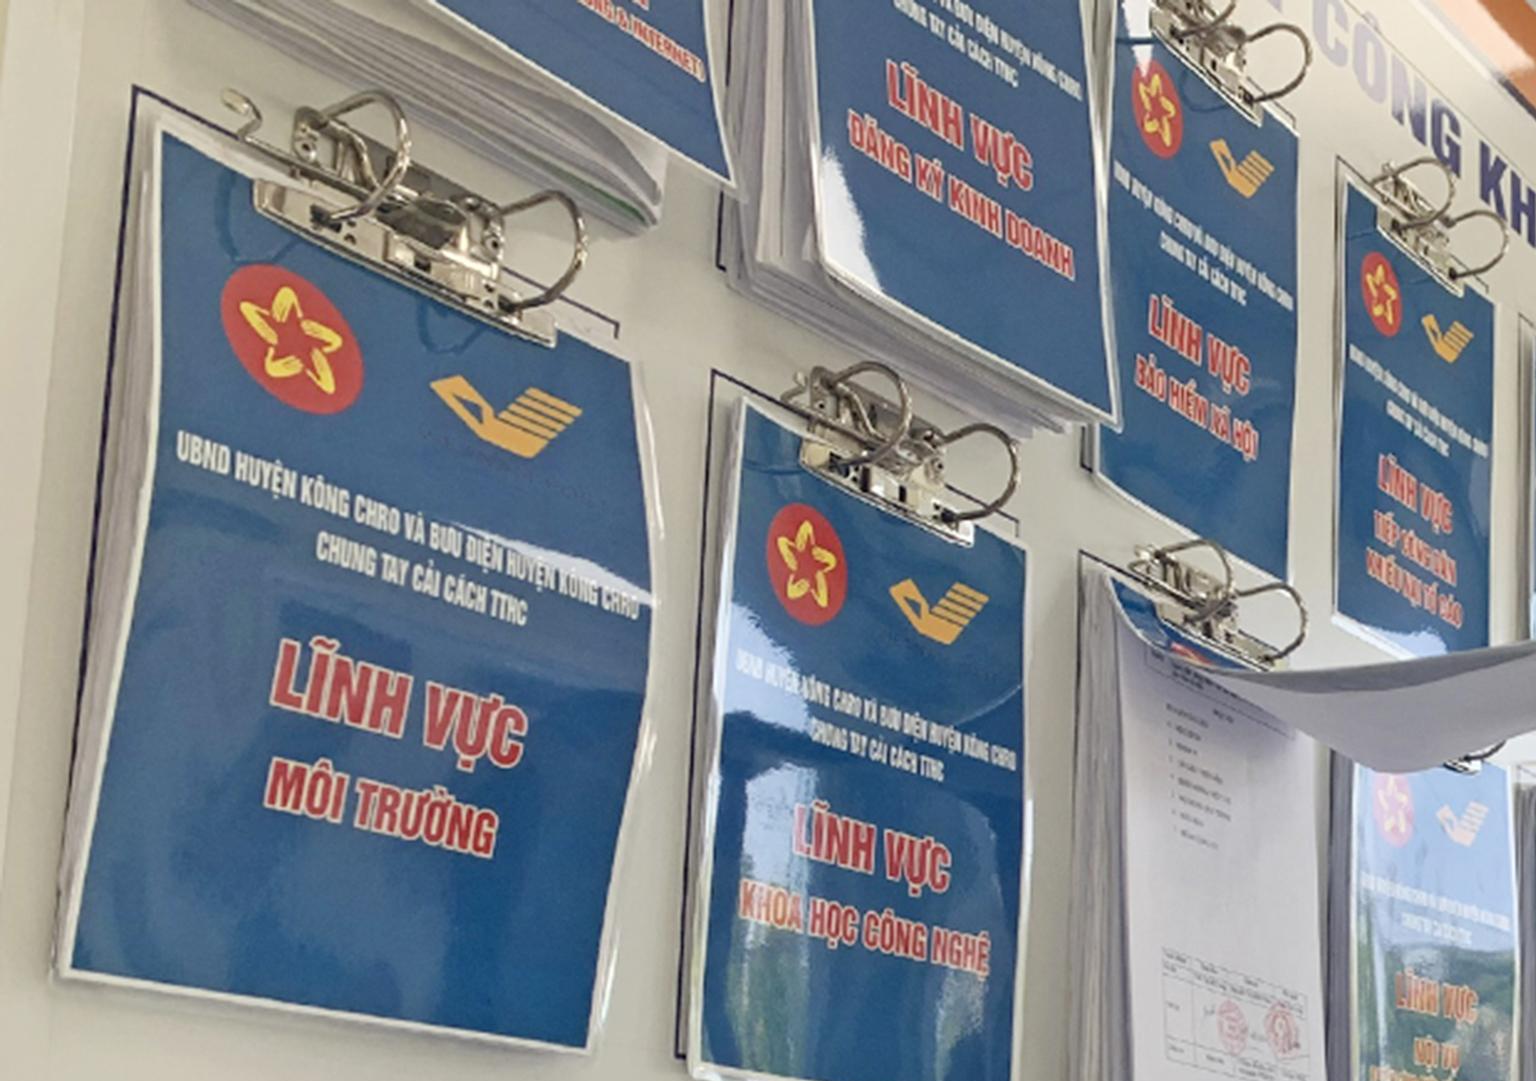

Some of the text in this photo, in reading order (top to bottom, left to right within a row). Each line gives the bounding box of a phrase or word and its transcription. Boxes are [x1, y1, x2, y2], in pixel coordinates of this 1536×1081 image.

[886, 58, 1033, 192] LĨNH VỰC
[848, 107, 912, 184] ĐĂNG
[914, 152, 944, 203] KÝ
[948, 172, 1003, 240] KINH
[1004, 208, 1076, 282] DOANH
[1148, 293, 1251, 397] LĨNH VỰC
[176, 430, 230, 476] UBND
[235, 453, 298, 500] HUYỆN
[300, 474, 350, 519] KÔNG
[354, 494, 402, 537] CHRO
[403, 511, 426, 545] VÀ
[465, 532, 504, 574] ĐIỆN
[506, 546, 557, 594] HUYỆN
[558, 566, 599, 604] KÔNG
[600, 583, 640, 621] CHRO
[315, 531, 528, 627] CHUNG TAY CẢI CÁCH TTHC
[270, 635, 528, 773] LĨNH VỰC
[264, 757, 500, 859] MÔI TRƯỜNG
[792, 800, 952, 898] LĨNH VỰC
[739, 878, 992, 983] KHOA HỌC CÔNG NGHỆ
